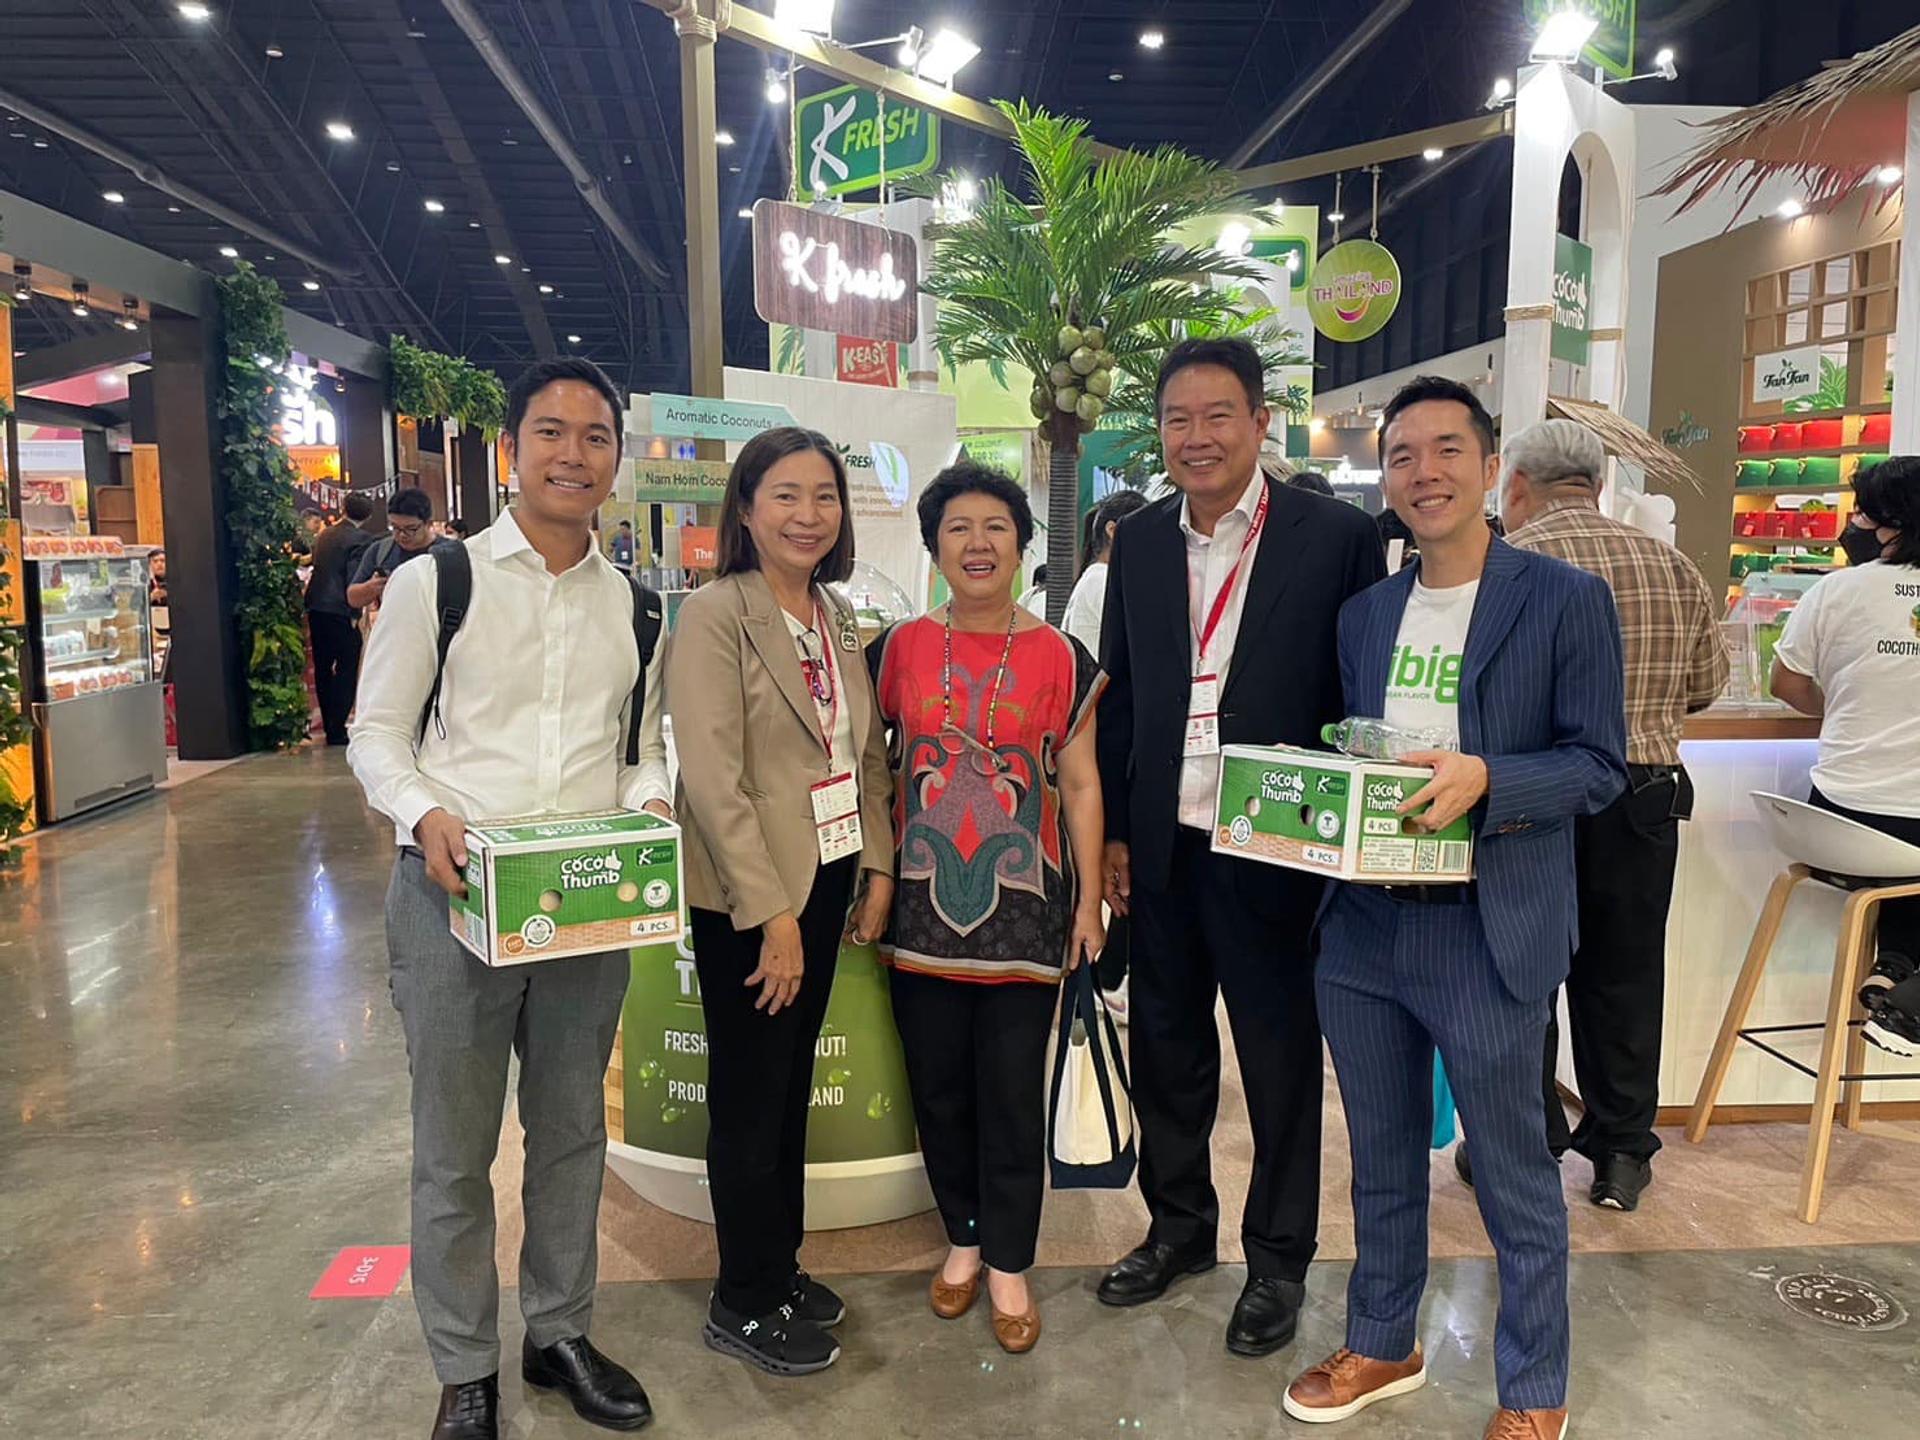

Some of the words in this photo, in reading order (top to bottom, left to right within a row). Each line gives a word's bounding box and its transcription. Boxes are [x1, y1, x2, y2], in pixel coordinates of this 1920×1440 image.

[810, 95, 858, 188] K
[842, 106, 920, 155] FRESH
[1313, 279, 1393, 303] THAILAND
[666, 407, 718, 425] Aromatic
[720, 413, 772, 429] Coconuts
[845, 455, 877, 469] FRESH
[646, 472, 671, 485] Nam
[674, 474, 699, 487] Hom
[694, 548, 714, 560] The
[1878, 640, 1920, 656] COCOTH
[1261, 785, 1302, 803] Thumb
[1368, 820, 1375, 830] 4
[1307, 848, 1314, 858] 4
[561, 870, 620, 889] Thumb
[637, 923, 645, 932] 4
[664, 1030, 708, 1055] FRESH
[808, 1086, 844, 1107] AND
